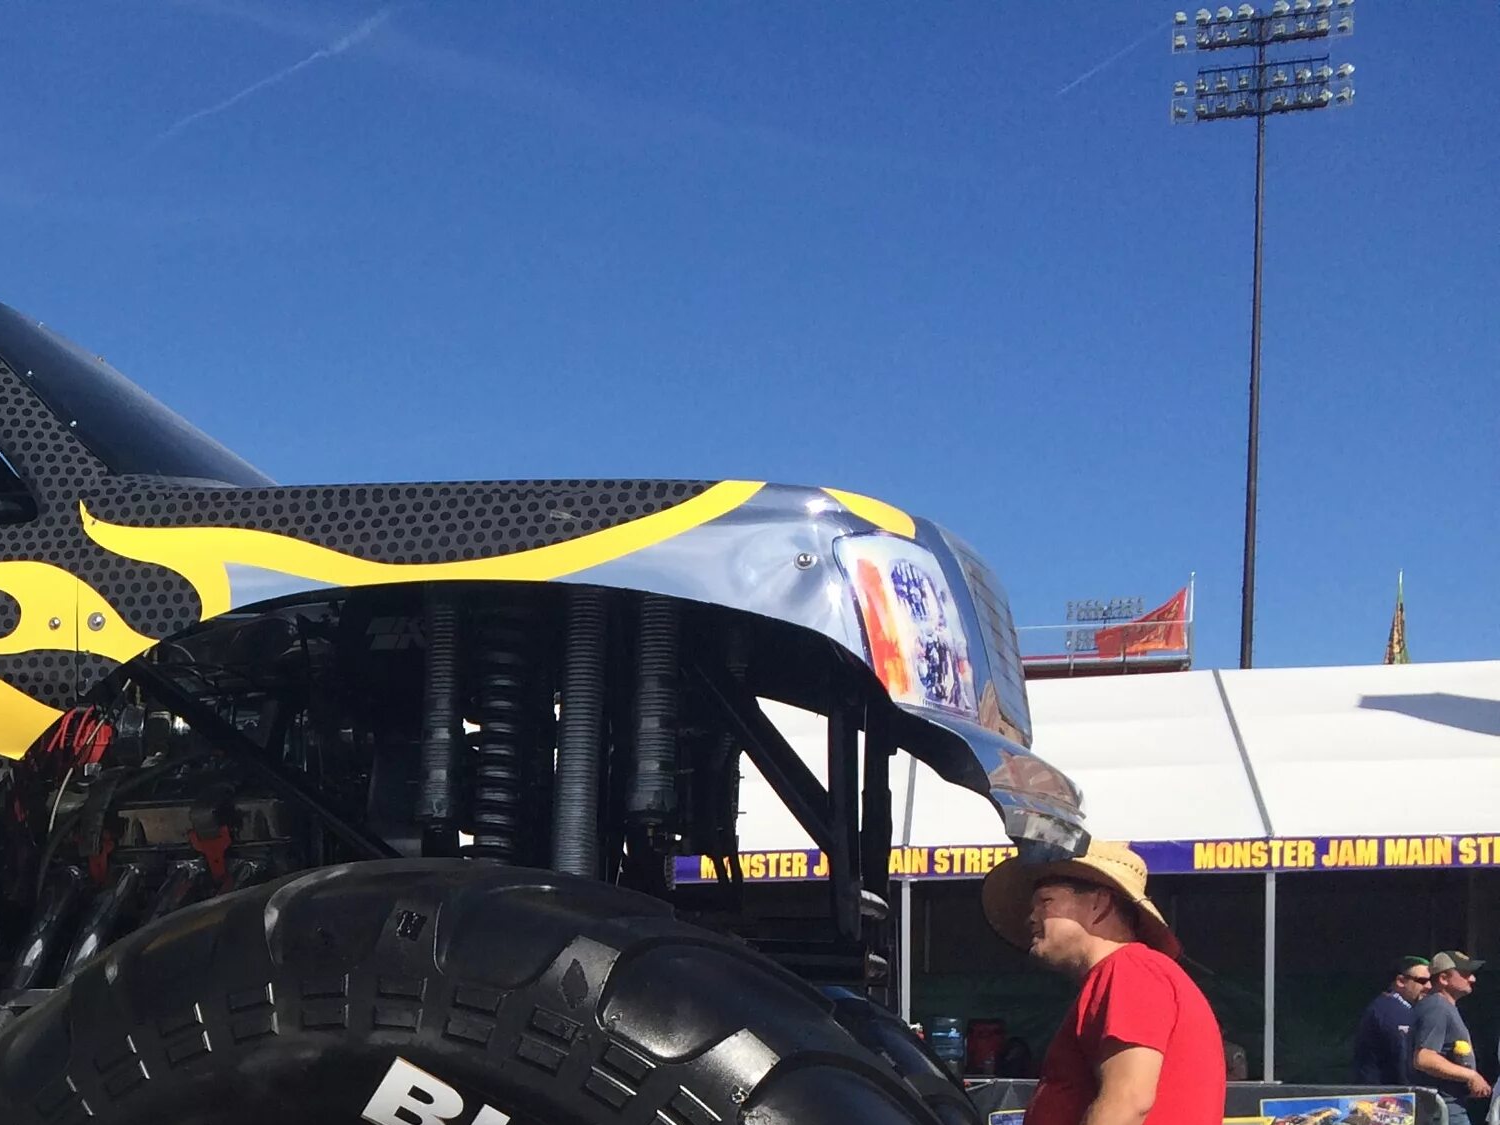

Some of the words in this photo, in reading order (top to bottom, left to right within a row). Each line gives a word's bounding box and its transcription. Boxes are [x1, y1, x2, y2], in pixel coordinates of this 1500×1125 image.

[888, 847, 928, 874] AIN
[1194, 839, 1315, 870] MONSTER
[1322, 839, 1378, 867] JAM
[1384, 837, 1452, 866] MAIN
